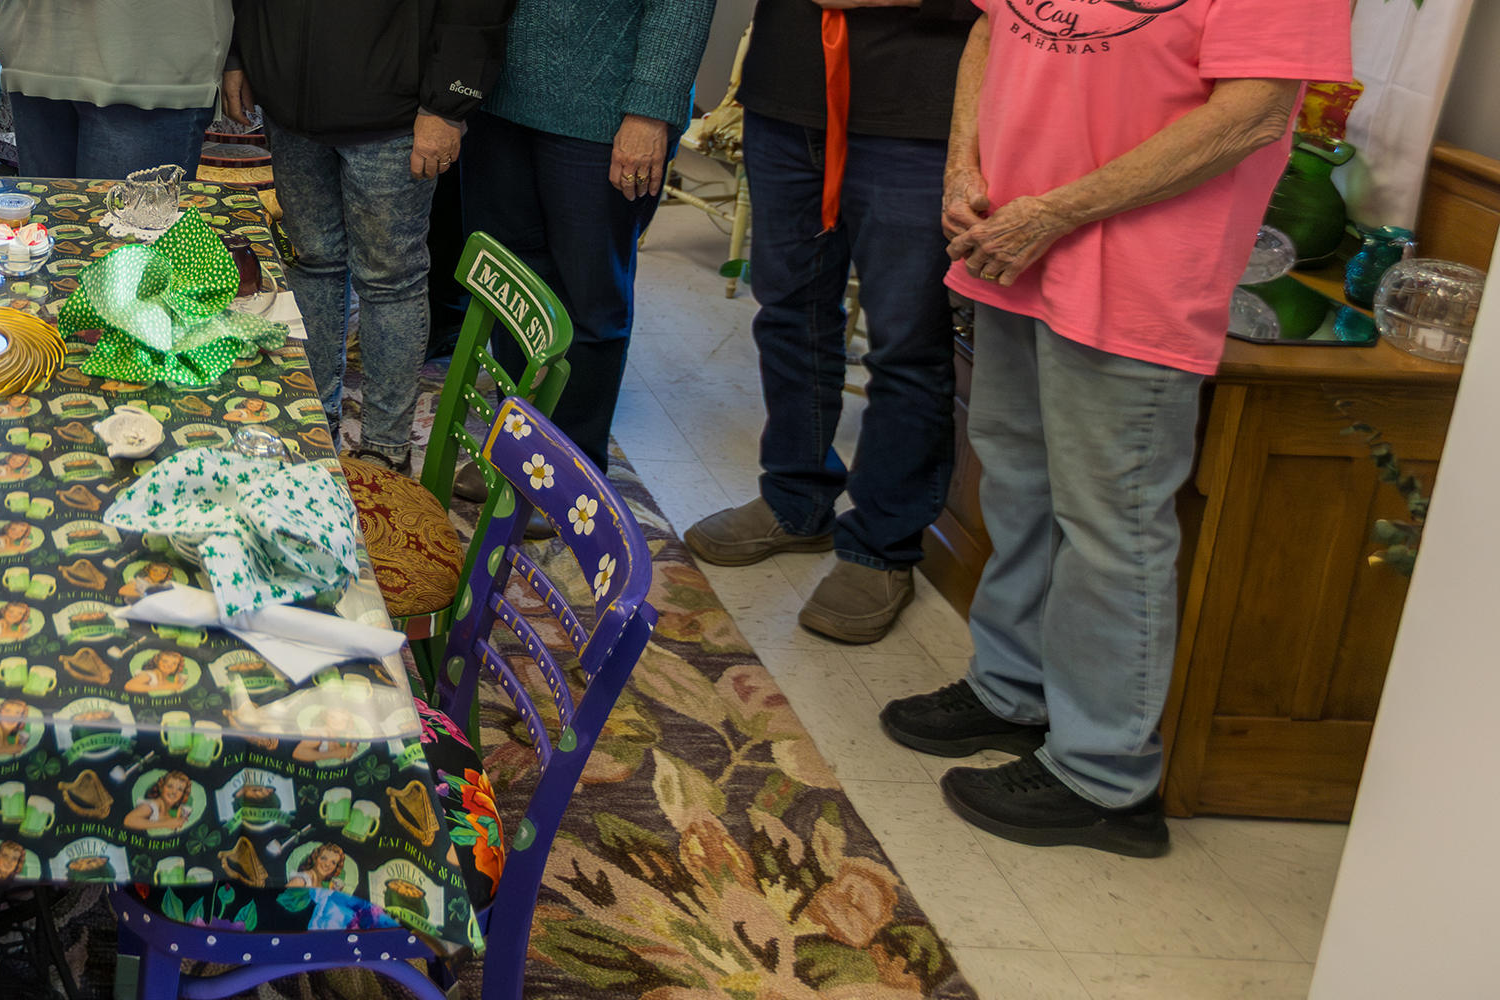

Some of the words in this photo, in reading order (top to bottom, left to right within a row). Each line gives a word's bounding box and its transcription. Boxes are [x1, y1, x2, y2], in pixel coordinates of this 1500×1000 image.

[1035, 0, 1080, 37] Cay
[1009, 22, 1111, 55] BAHAMAS
[477, 262, 530, 324] MAIN
[222, 751, 246, 768] EAT
[248, 752, 283, 770] DRINK
[285, 762, 296, 775] &
[298, 765, 313, 778] BE
[316, 766, 350, 781] IRISH
[55, 823, 77, 837] EAT
[80, 822, 116, 839] DRINK
[118, 829, 129, 843] &
[131, 834, 145, 848] BE
[148, 836, 180, 851] IRISH
[378, 835, 400, 849] EAT
[404, 840, 436, 873] DRINK
[438, 864, 449, 880] &
[386, 861, 427, 887] O'DELL'S
